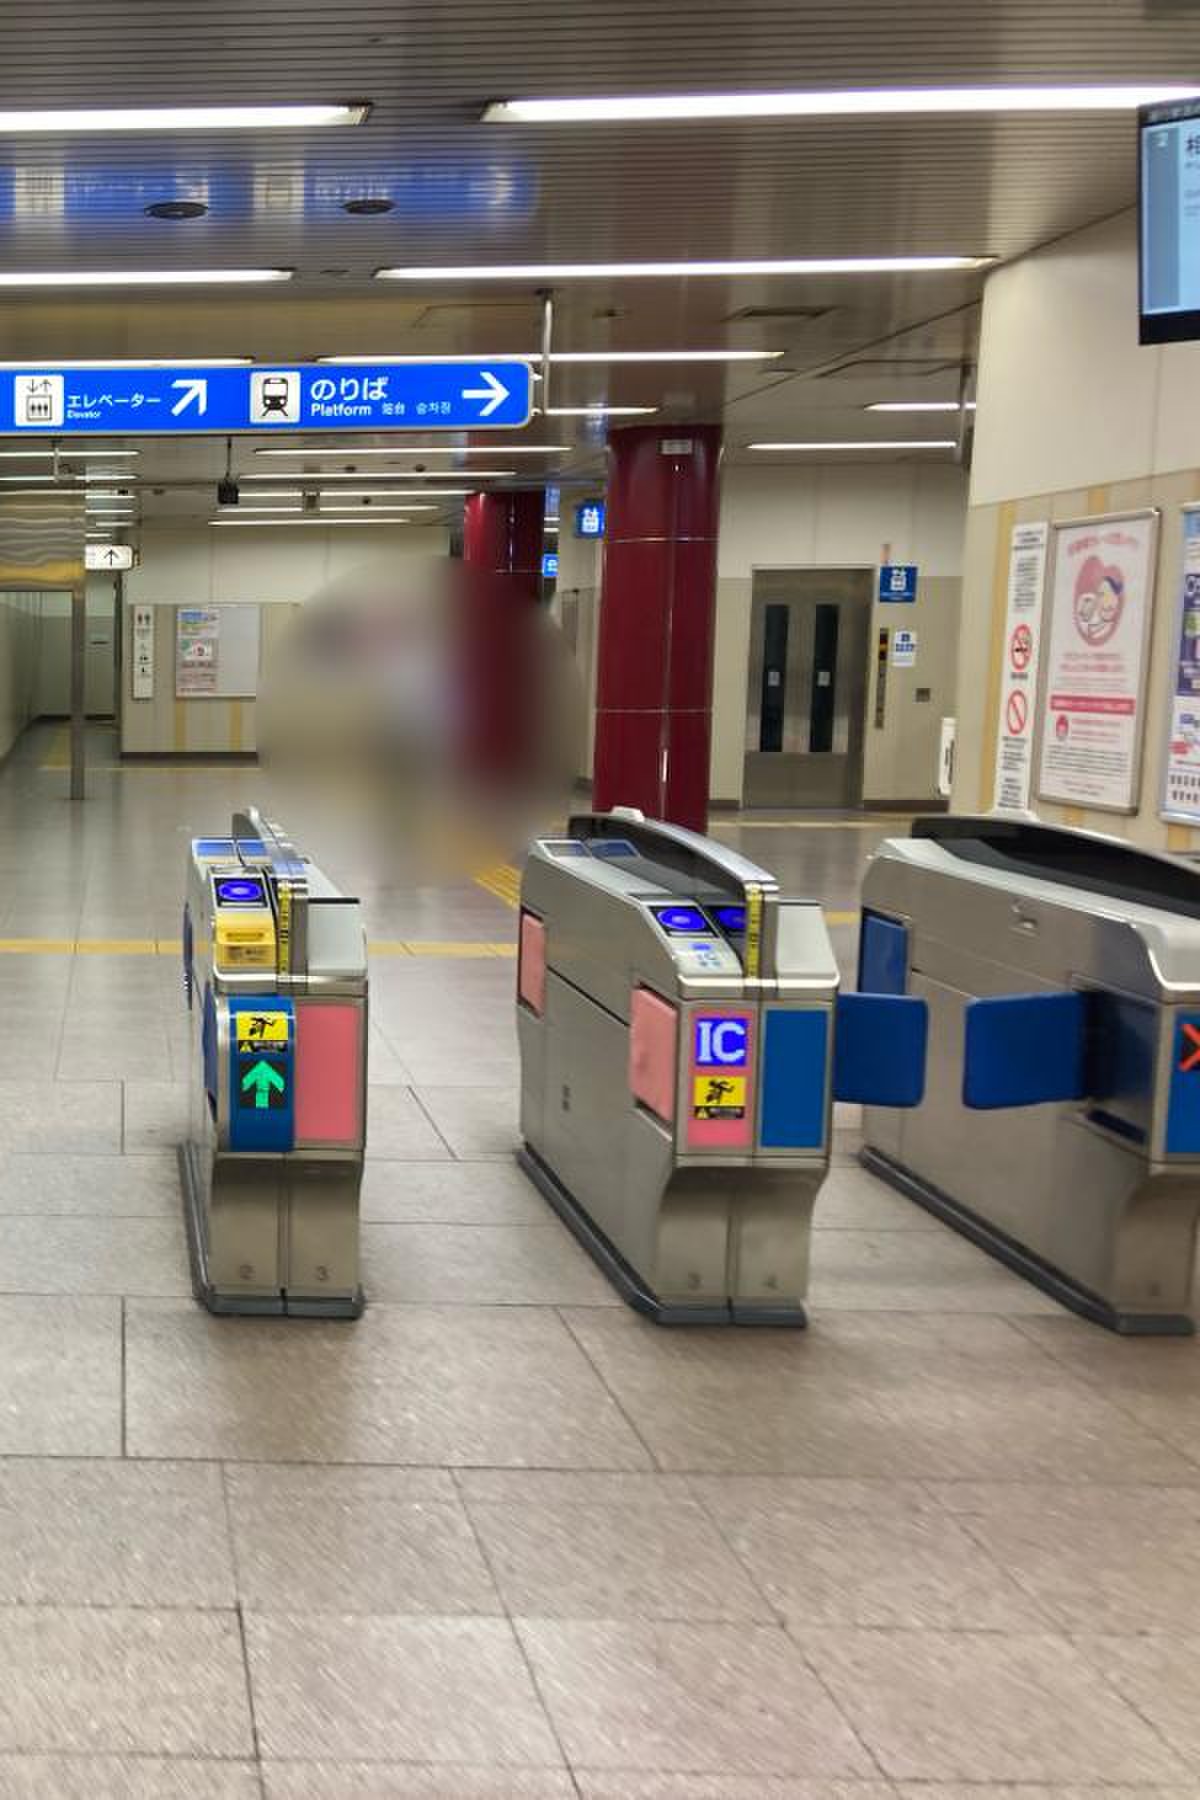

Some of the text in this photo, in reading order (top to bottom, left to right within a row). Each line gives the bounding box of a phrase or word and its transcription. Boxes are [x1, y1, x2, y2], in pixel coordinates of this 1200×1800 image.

[310, 377, 390, 401] のりば
[67, 394, 161, 408] エレベーター
[67, 410, 101, 419] Elevator
[311, 403, 372, 416] Platform
[698, 1021, 745, 1063] IC
